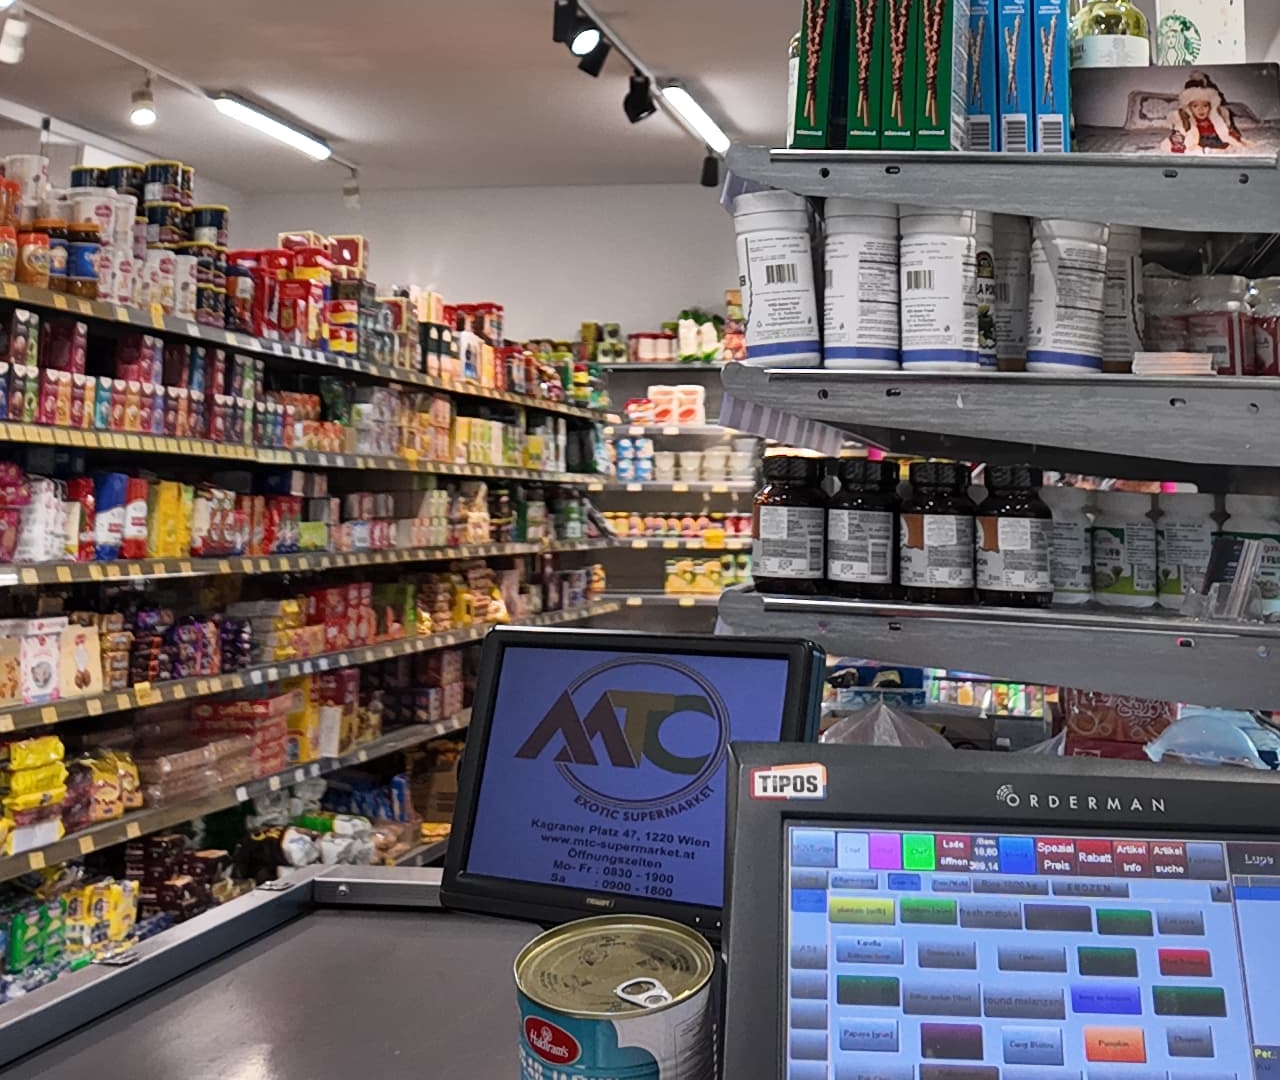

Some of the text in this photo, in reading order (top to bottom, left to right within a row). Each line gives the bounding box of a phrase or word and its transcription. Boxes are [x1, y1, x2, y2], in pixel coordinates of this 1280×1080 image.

[515, 689, 716, 775] MTC
[758, 773, 818, 794] TIPOS
[573, 784, 715, 822] EXOTIC SUPERMARKET
[1006, 792, 1166, 812] ORDERMAN
[531, 819, 585, 834] Kagraner
[588, 824, 619, 838] Platz
[645, 831, 674, 844] 1220
[677, 835, 710, 849] Wien
[943, 840, 965, 849] Lade
[541, 833, 695, 861] www.mtc-supermarket.at
[567, 847, 662, 869] Öffnungszeiten
[1037, 841, 1075, 871] Spezial Preis
[1078, 852, 1113, 864] Rabatt
[1116, 845, 1147, 855] Artikel
[1153, 846, 1184, 874] Artikel suche
[550, 872, 566, 883] Sa
[601, 880, 631, 892] 0900
[644, 884, 673, 897] 1800
[578, 864, 592, 874] Fr
[602, 866, 633, 879] 0830
[645, 871, 674, 885] 1900
